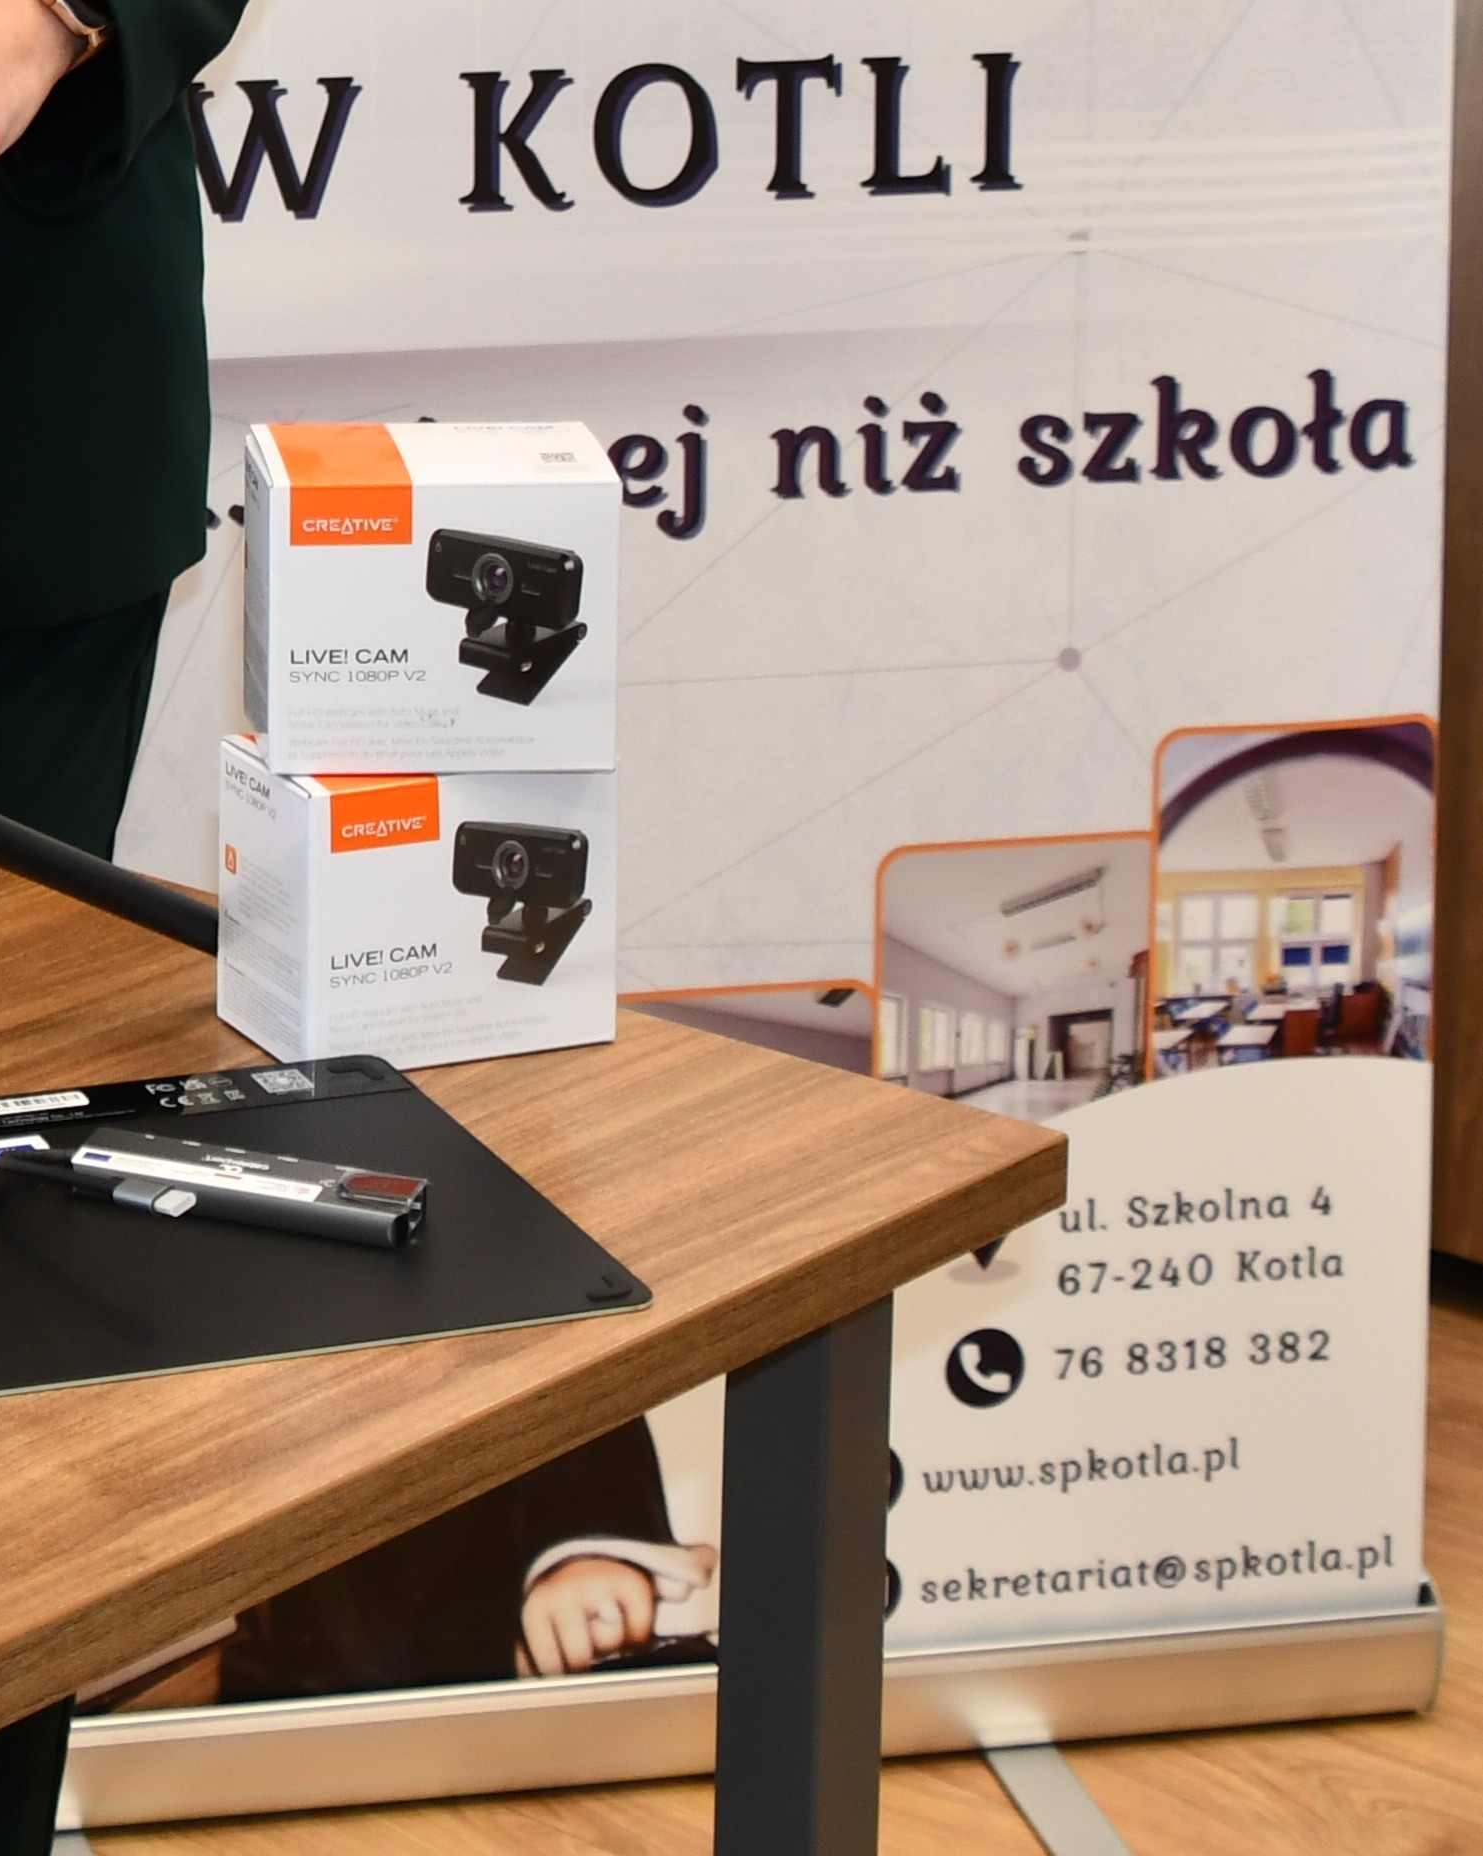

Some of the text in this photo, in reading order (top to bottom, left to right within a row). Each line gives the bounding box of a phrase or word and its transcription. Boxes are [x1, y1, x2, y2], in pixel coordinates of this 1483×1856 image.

[190, 52, 1026, 223] W KOTLI
[770, 390, 961, 502] niż
[1017, 368, 1414, 492] szkoła
[289, 670, 426, 683] SYNC 1080P V2
[290, 649, 409, 664] LIVE! CAM
[225, 761, 270, 800] LIVE! CAM
[329, 943, 438, 971] LIVE! CAM
[329, 962, 453, 988] SYNC 1080P V2
[1058, 1186, 1333, 1234] ul. Szkolna 4
[1057, 1246, 1344, 1296] 67-240 Kotla
[1053, 1330, 1332, 1381] 76 8318 382
[922, 1437, 1242, 1494] www.spkotla.pl
[921, 1535, 1394, 1605] sekretariat@spkotla.pl
